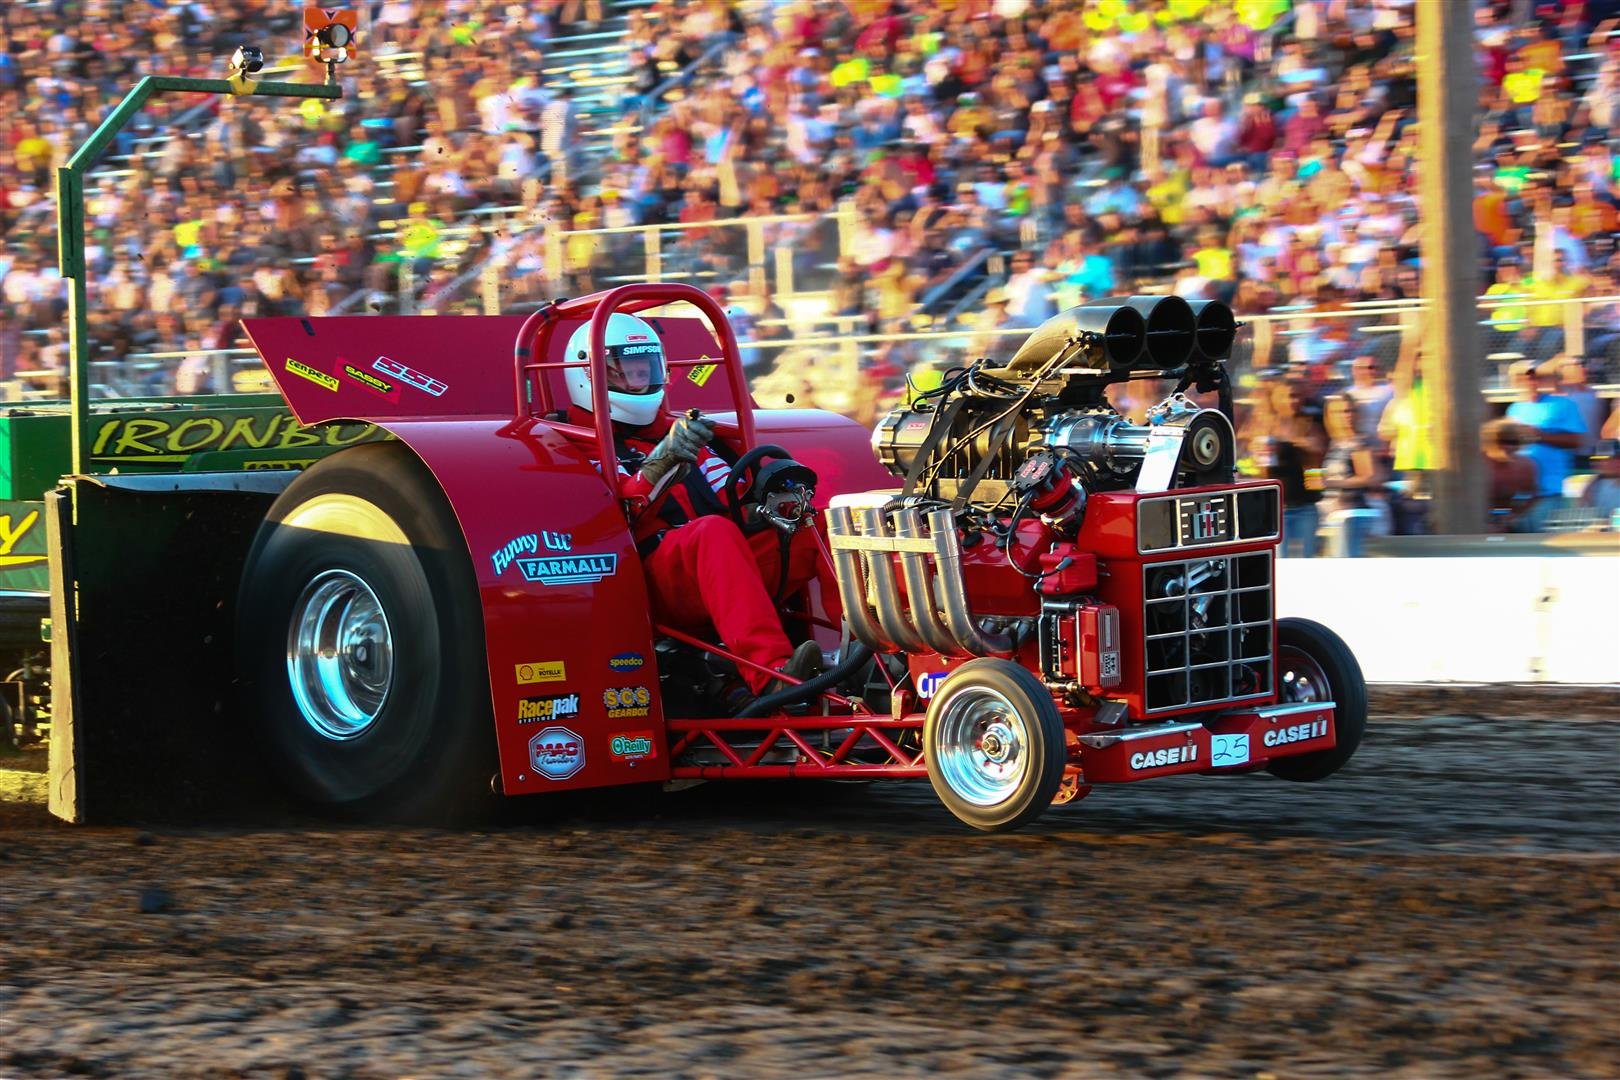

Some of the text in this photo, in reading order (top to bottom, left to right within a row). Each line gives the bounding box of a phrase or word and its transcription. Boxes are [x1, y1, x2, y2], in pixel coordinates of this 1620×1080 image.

[345, 366, 392, 391] SASSY
[93, 413, 396, 455] IRONBU
[491, 534, 538, 575] Funny
[527, 558, 612, 577] FARMALL
[610, 657, 643, 668] speedco
[518, 694, 579, 720] Racepak
[606, 688, 647, 706] SCS
[608, 707, 649, 718] GEARBOX
[536, 742, 578, 757] MAC
[1213, 735, 1248, 760] 25
